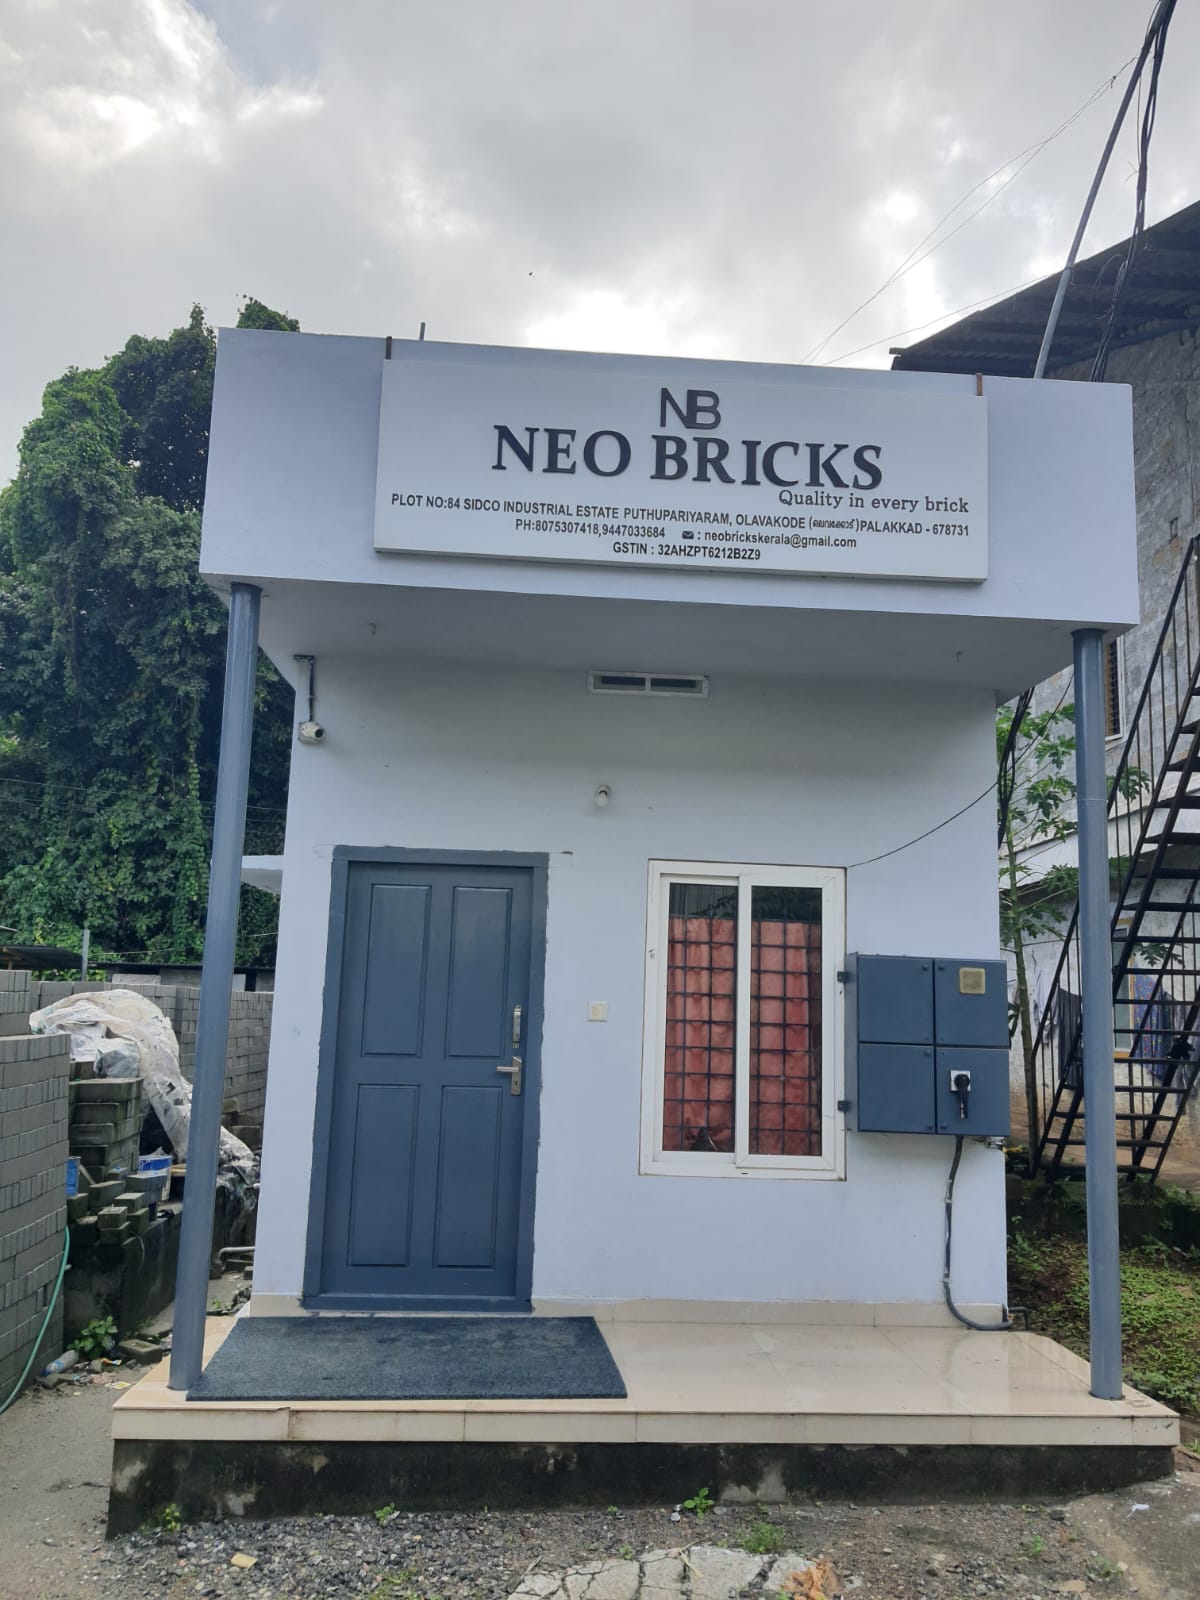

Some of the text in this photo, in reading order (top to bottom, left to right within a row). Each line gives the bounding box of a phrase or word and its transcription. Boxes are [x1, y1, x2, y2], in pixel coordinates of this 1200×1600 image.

[660, 387, 721, 430] NB
[491, 424, 883, 490] NEO BRICKS
[391, 493, 806, 529] PLOT NO:84 SIDCO INDUSTRIAL ESTATE PUTHUPARIYARAM, OLAVAKODE
[779, 489, 969, 513] Quality in every brick
[704, 531, 858, 549] neobrickskerala@gmail.com
[931, 523, 970, 537] 678731
[613, 541, 648, 555] GSTIN
[658, 543, 761, 561] 32AHZPT6212B2Z9
